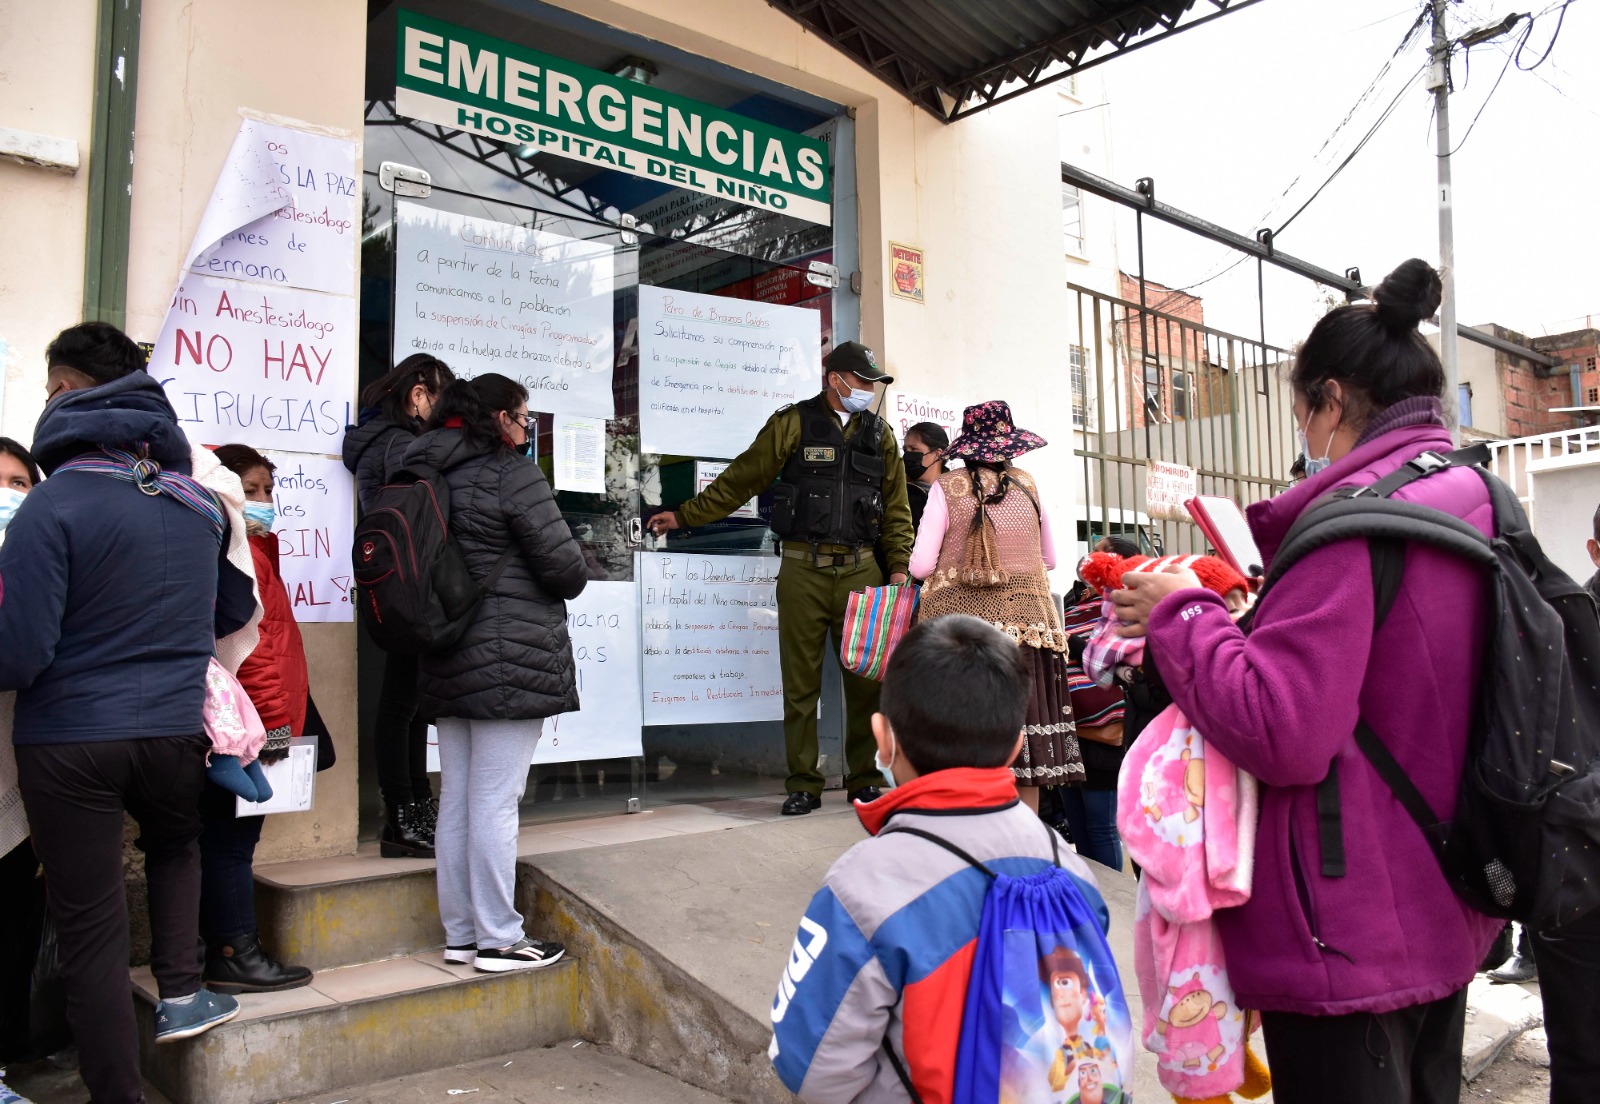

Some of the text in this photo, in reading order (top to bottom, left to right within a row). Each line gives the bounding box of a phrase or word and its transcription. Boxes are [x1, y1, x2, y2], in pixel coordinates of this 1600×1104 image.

[404, 26, 825, 191] EMERGENCIAS
[457, 108, 788, 210] HOSPITAL DEL NIÑO
[276, 162, 355, 198] S LA PAZ
[670, 195, 690, 210] PARA
[1441, 189, 1446, 202] 1
[660, 201, 706, 227] URGENCIAS
[288, 233, 307, 253] de
[437, 252, 479, 275] partir
[486, 261, 502, 279] de
[511, 261, 520, 279] la
[529, 270, 560, 289] Fecha
[415, 282, 571, 318] comunicamos a la población
[692, 306, 704, 319] de
[216, 290, 335, 340] Anestesiólogo
[415, 301, 427, 320] la
[486, 313, 499, 330] de
[655, 320, 706, 343] Solicitamos
[174, 328, 232, 373] NO
[264, 338, 333, 386] HAY
[411, 336, 592, 371] debido a la huelga de brazos debido a
[652, 347, 660, 362] la
[651, 376, 660, 386] de
[702, 385, 715, 395] por
[717, 381, 724, 392] la
[273, 494, 306, 518] les
[276, 527, 331, 559] SIN
[661, 557, 678, 580] Por
[686, 557, 699, 581] los
[646, 587, 656, 605] El
[663, 588, 692, 609] Hospital
[693, 592, 707, 606] del
[691, 690, 700, 701] la
